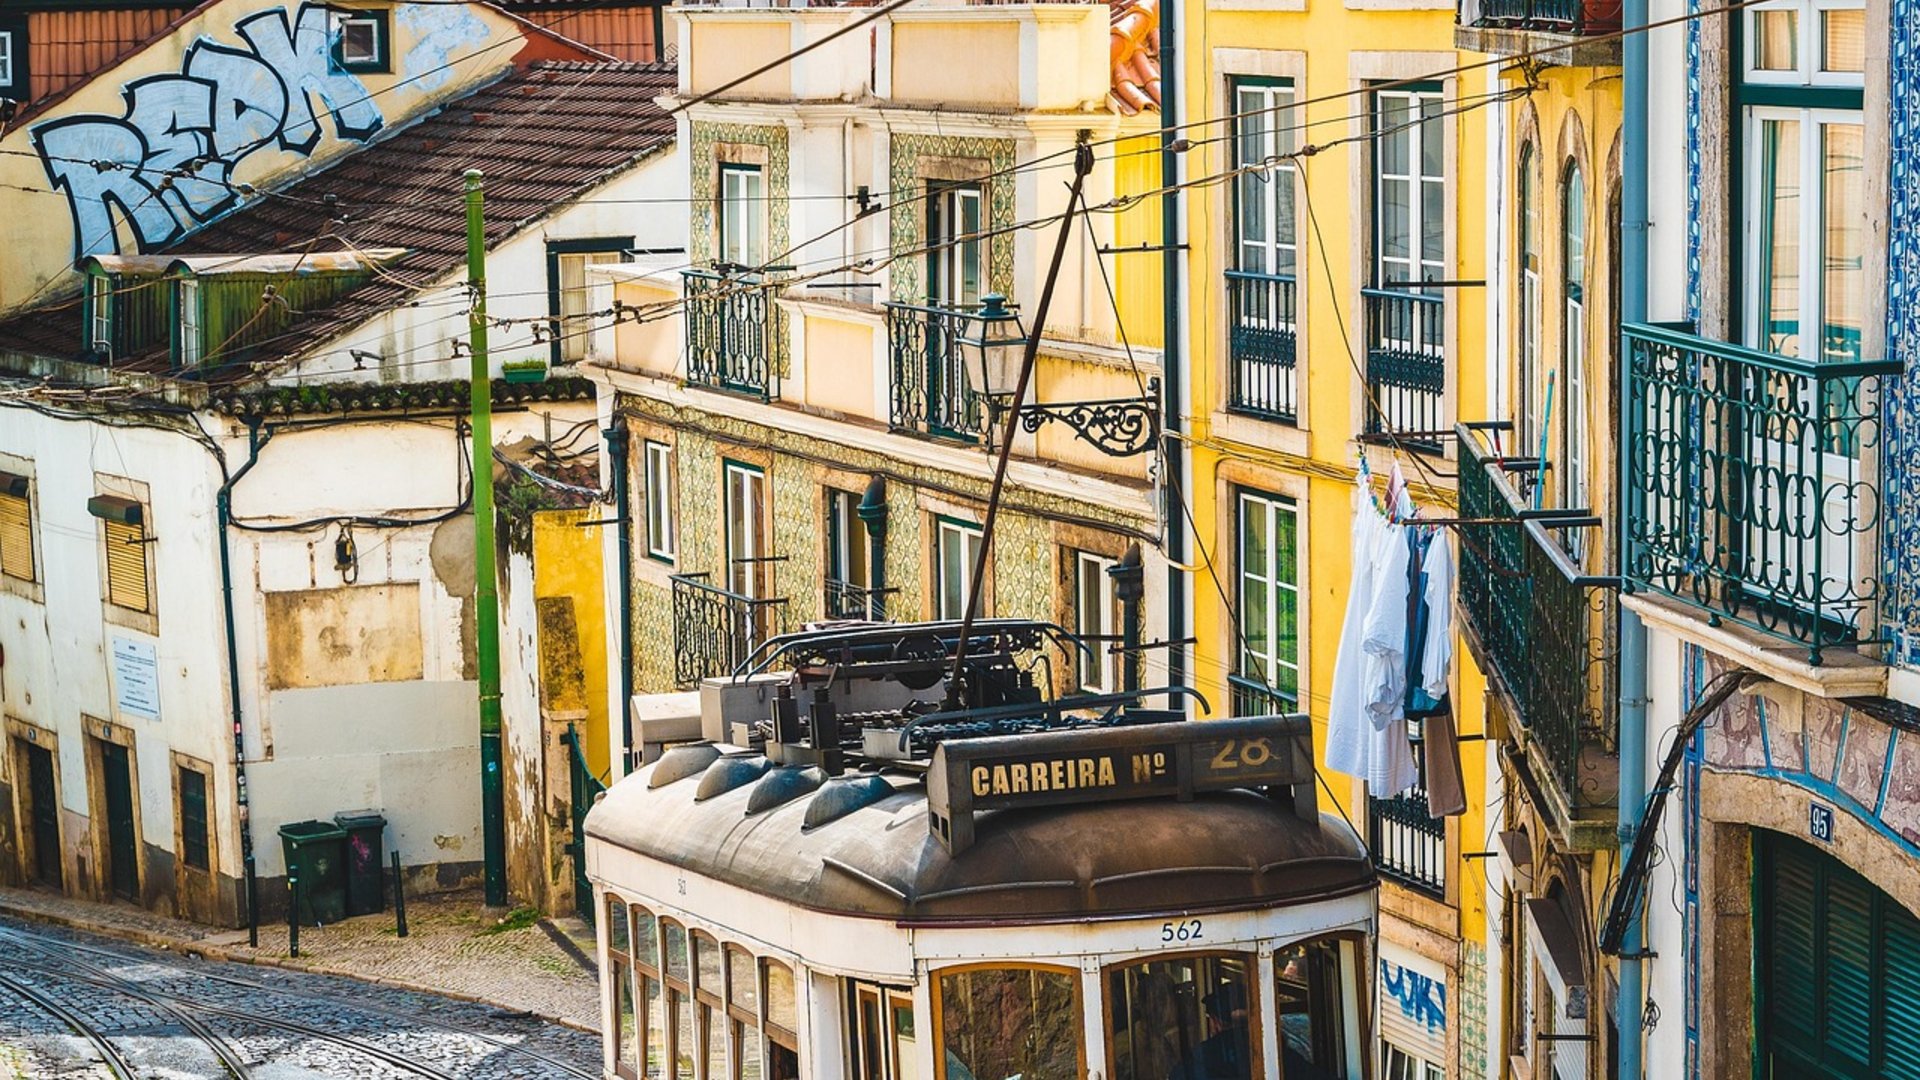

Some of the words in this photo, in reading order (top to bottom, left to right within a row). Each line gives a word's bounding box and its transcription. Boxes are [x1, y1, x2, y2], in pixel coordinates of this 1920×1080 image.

[971, 756, 1116, 797] CARREIRA
[1210, 738, 1270, 769] 28
[1812, 807, 1828, 838] 95
[1161, 919, 1203, 942] 562
